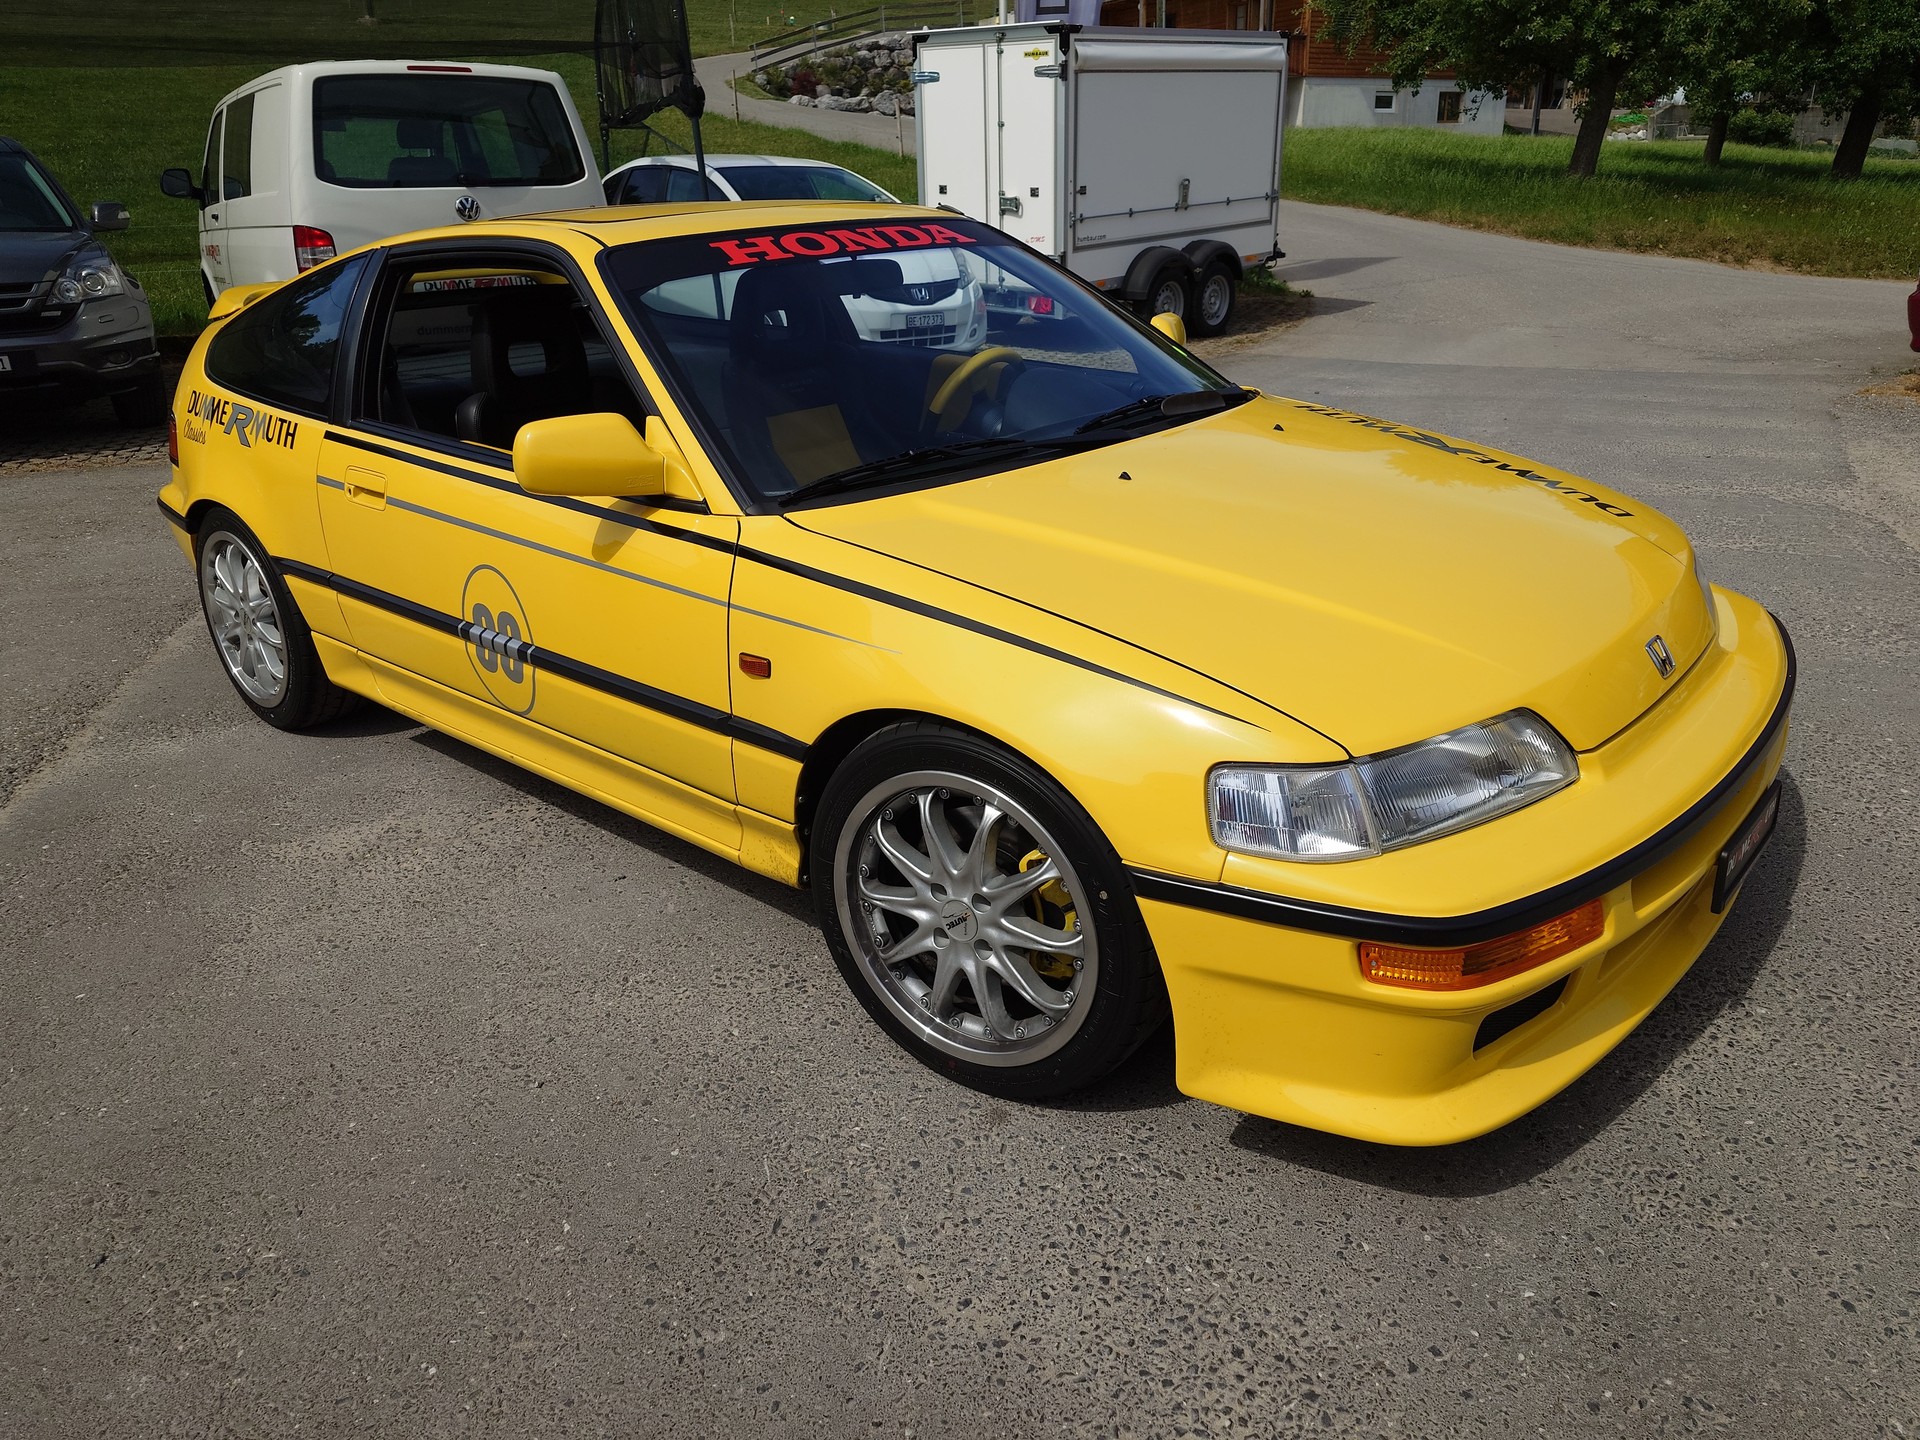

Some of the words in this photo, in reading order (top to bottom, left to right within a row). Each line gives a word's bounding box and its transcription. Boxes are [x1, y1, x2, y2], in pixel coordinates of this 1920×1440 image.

[709, 225, 977, 265] HONDA
[183, 418, 207, 445] Classics
[187, 390, 298, 450] DUMMERMUTH
